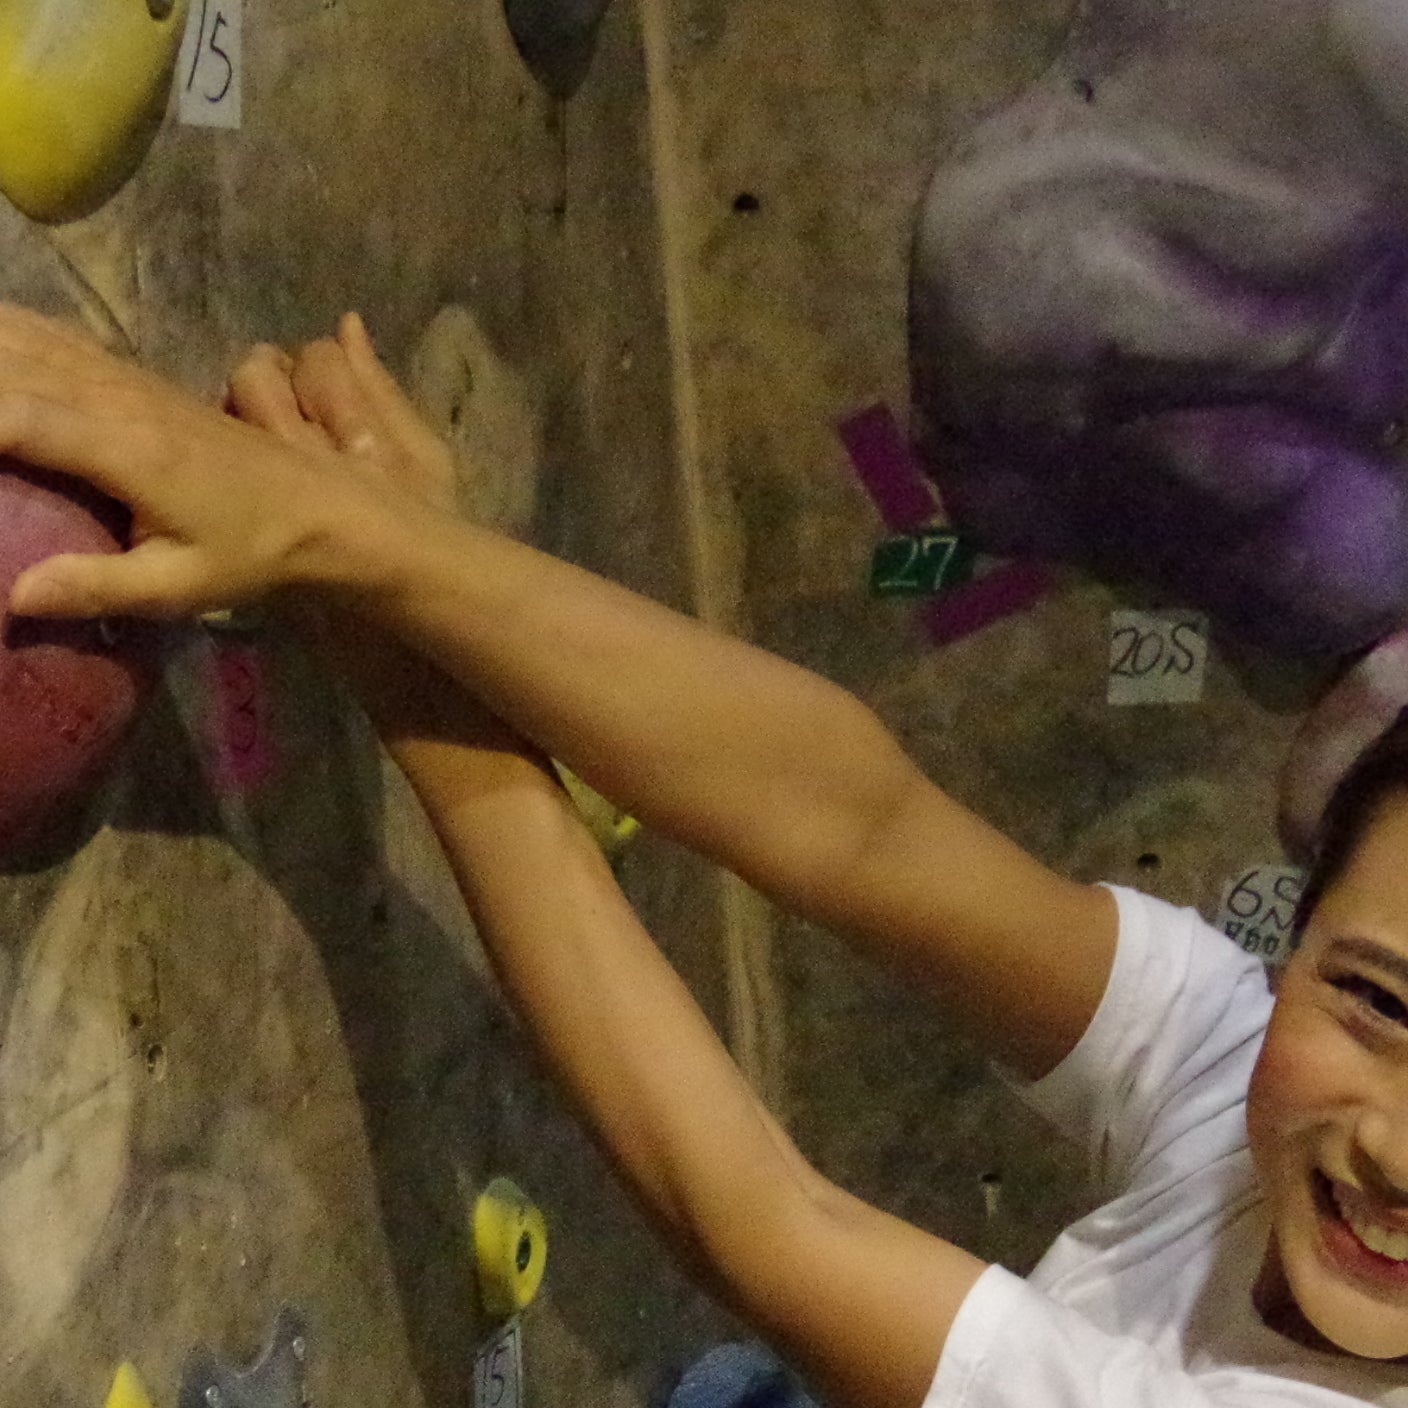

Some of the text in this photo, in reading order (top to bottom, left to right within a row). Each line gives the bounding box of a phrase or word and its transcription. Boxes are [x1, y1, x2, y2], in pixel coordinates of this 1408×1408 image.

[186, 0, 232, 103] 15
[878, 534, 959, 591] 27
[1111, 622, 1199, 677] 20S
